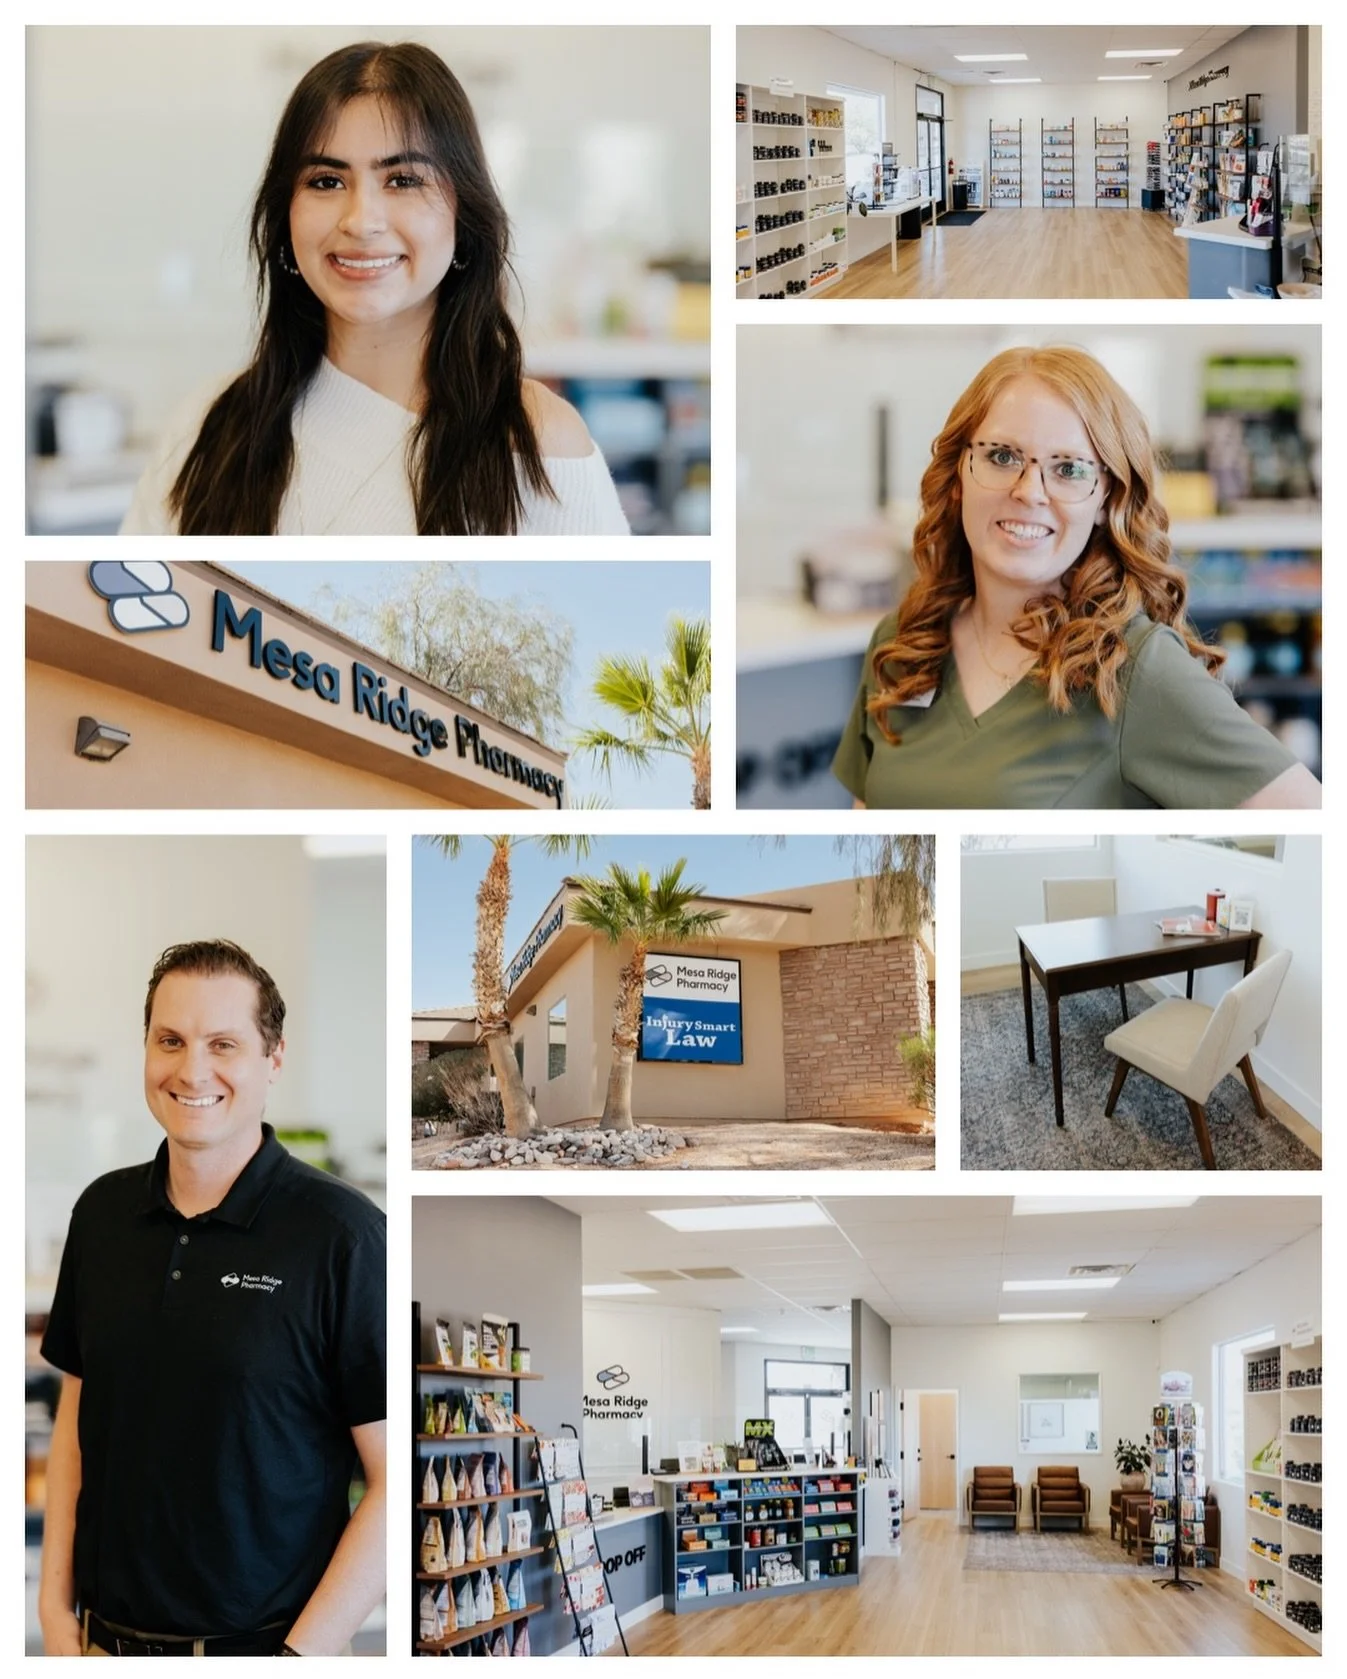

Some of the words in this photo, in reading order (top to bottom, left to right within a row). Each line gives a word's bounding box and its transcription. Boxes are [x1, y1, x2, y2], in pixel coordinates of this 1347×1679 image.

[212, 589, 340, 704] Mesa
[352, 661, 448, 757] Ridge
[454, 714, 564, 810] Pharmacy
[676, 966, 705, 978] Mesa
[707, 968, 737, 982] Ridge
[676, 978, 729, 993] Pharmacy
[646, 1014, 693, 1032] Injury
[694, 1020, 736, 1032] Smart
[665, 1028, 717, 1048] Law
[240, 1281, 276, 1293] Pharmacy
[242, 1274, 260, 1282] Mesa
[261, 1275, 283, 1287] Ridge
[614, 1395, 649, 1410] Ridge
[602, 1554, 623, 1574] OP
[624, 1545, 646, 1566] OFF
